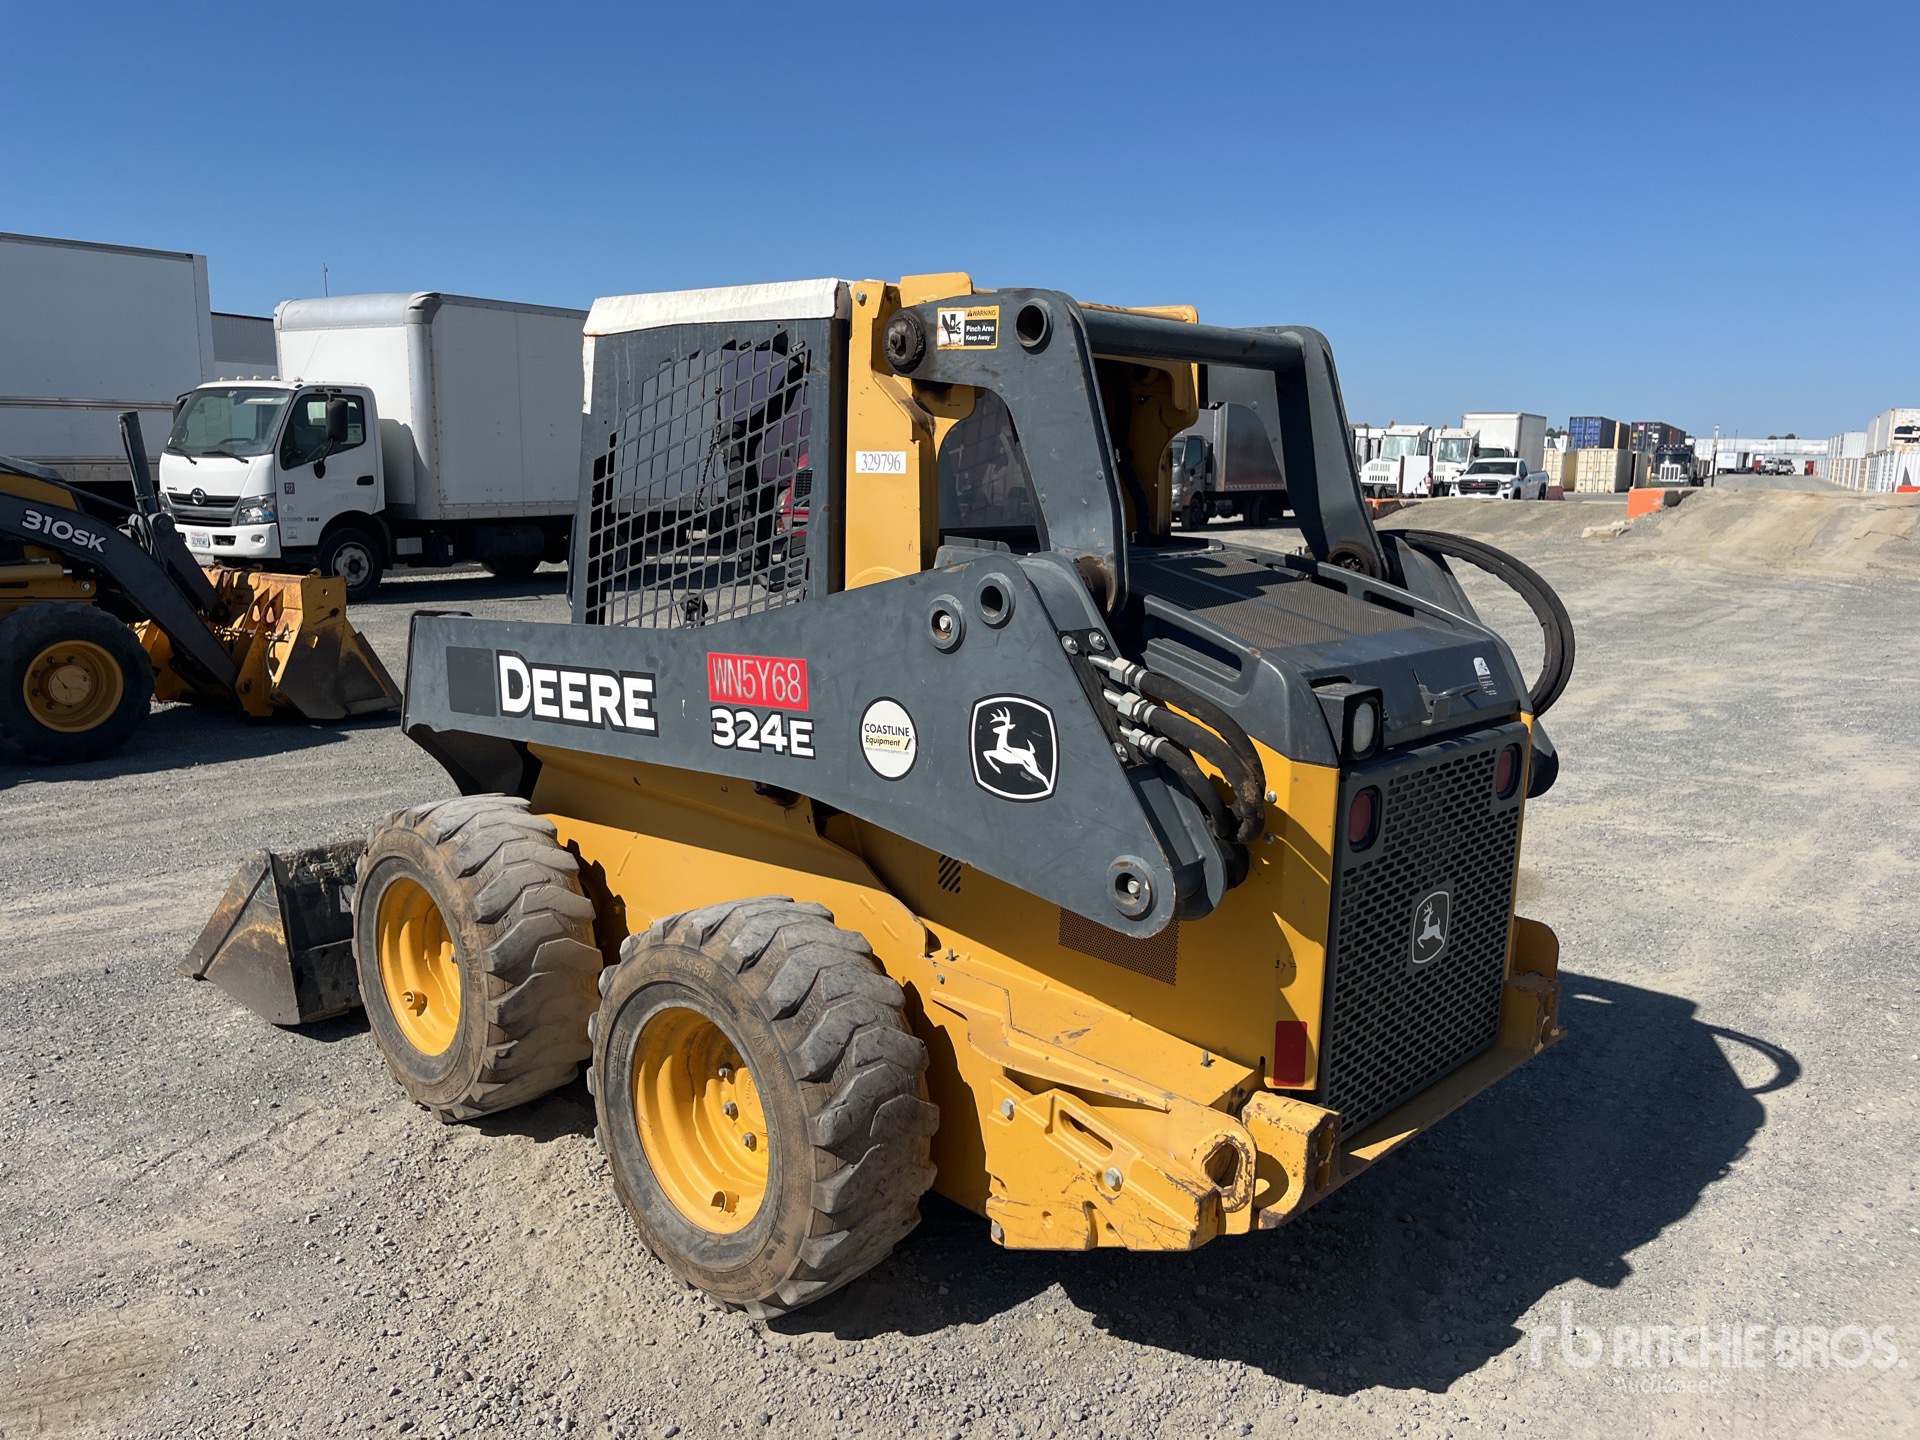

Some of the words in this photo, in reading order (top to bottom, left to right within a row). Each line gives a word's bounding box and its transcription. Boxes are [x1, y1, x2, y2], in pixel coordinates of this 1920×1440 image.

[972, 309, 996, 317] WARNING
[965, 325, 981, 333] Pinch
[861, 453, 901, 471] 329796
[21, 509, 107, 553] 310SK
[711, 657, 801, 703] WN5Y68
[498, 654, 656, 731] DEERE
[710, 707, 815, 757] 324E
[864, 723, 910, 737] COASTLINE
[865, 735, 901, 746] Equipment
[693, 964, 712, 982] 532
